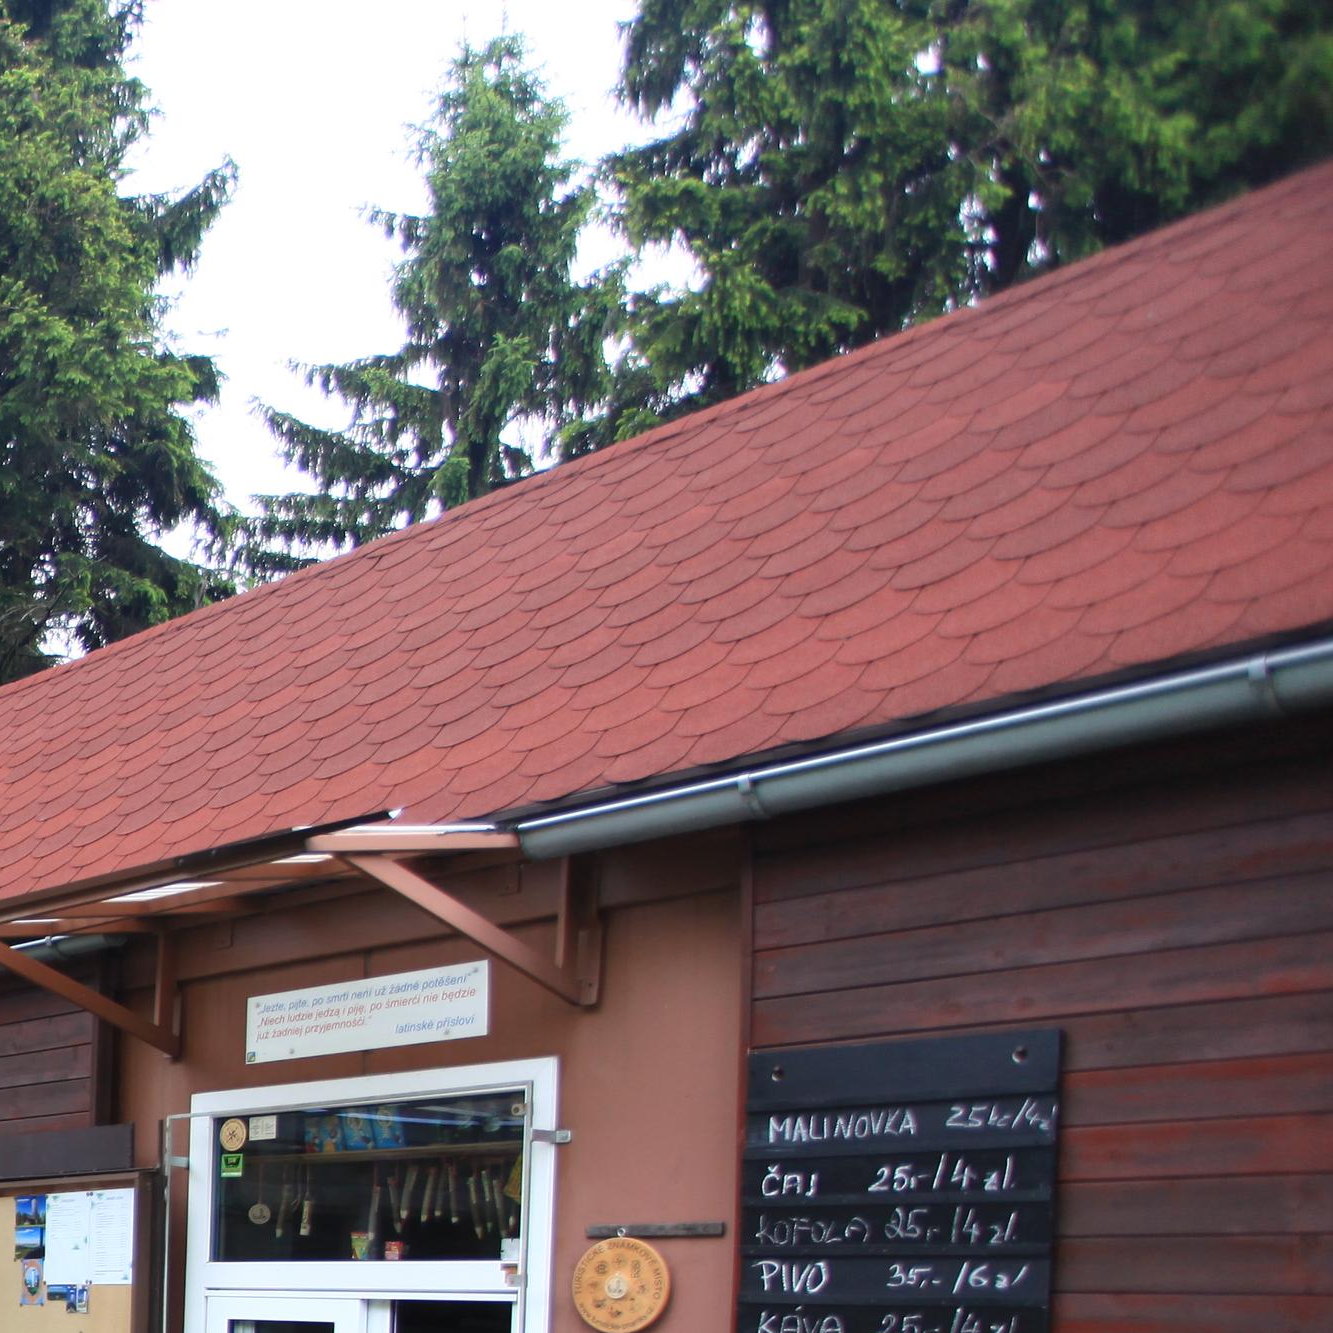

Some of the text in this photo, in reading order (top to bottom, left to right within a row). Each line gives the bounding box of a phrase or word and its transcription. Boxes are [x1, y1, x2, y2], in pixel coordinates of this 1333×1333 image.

[369, 1001, 383, 1013] po
[423, 992, 438, 1004] nie
[767, 1107, 917, 1145] MALINOVKA
[761, 1163, 820, 1197] ČAJ
[754, 1213, 870, 1247] KOFOLA
[750, 1260, 828, 1294] PIVO
